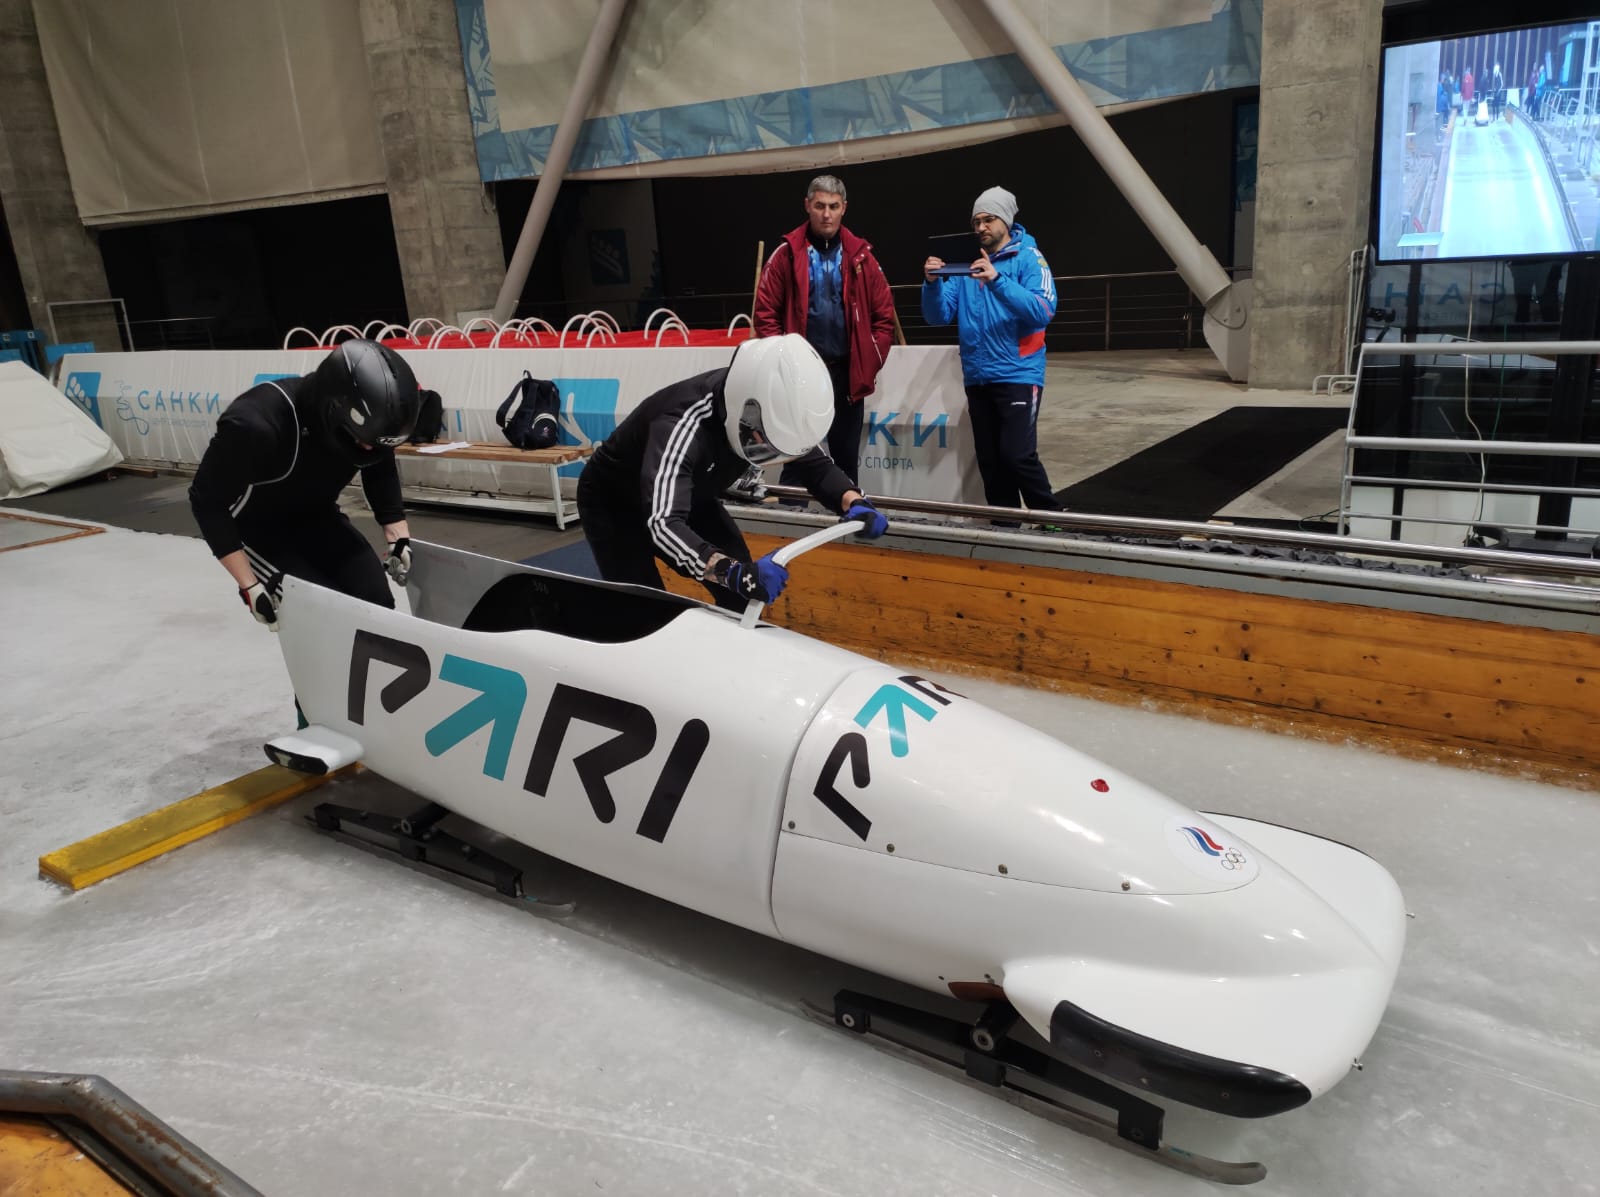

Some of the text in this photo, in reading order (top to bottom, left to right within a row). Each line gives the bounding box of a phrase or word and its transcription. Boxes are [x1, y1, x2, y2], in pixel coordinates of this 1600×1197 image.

[137, 389, 221, 415] САНКИ
[864, 456, 914, 471] СПОРТА
[347, 628, 711, 844] PARI
